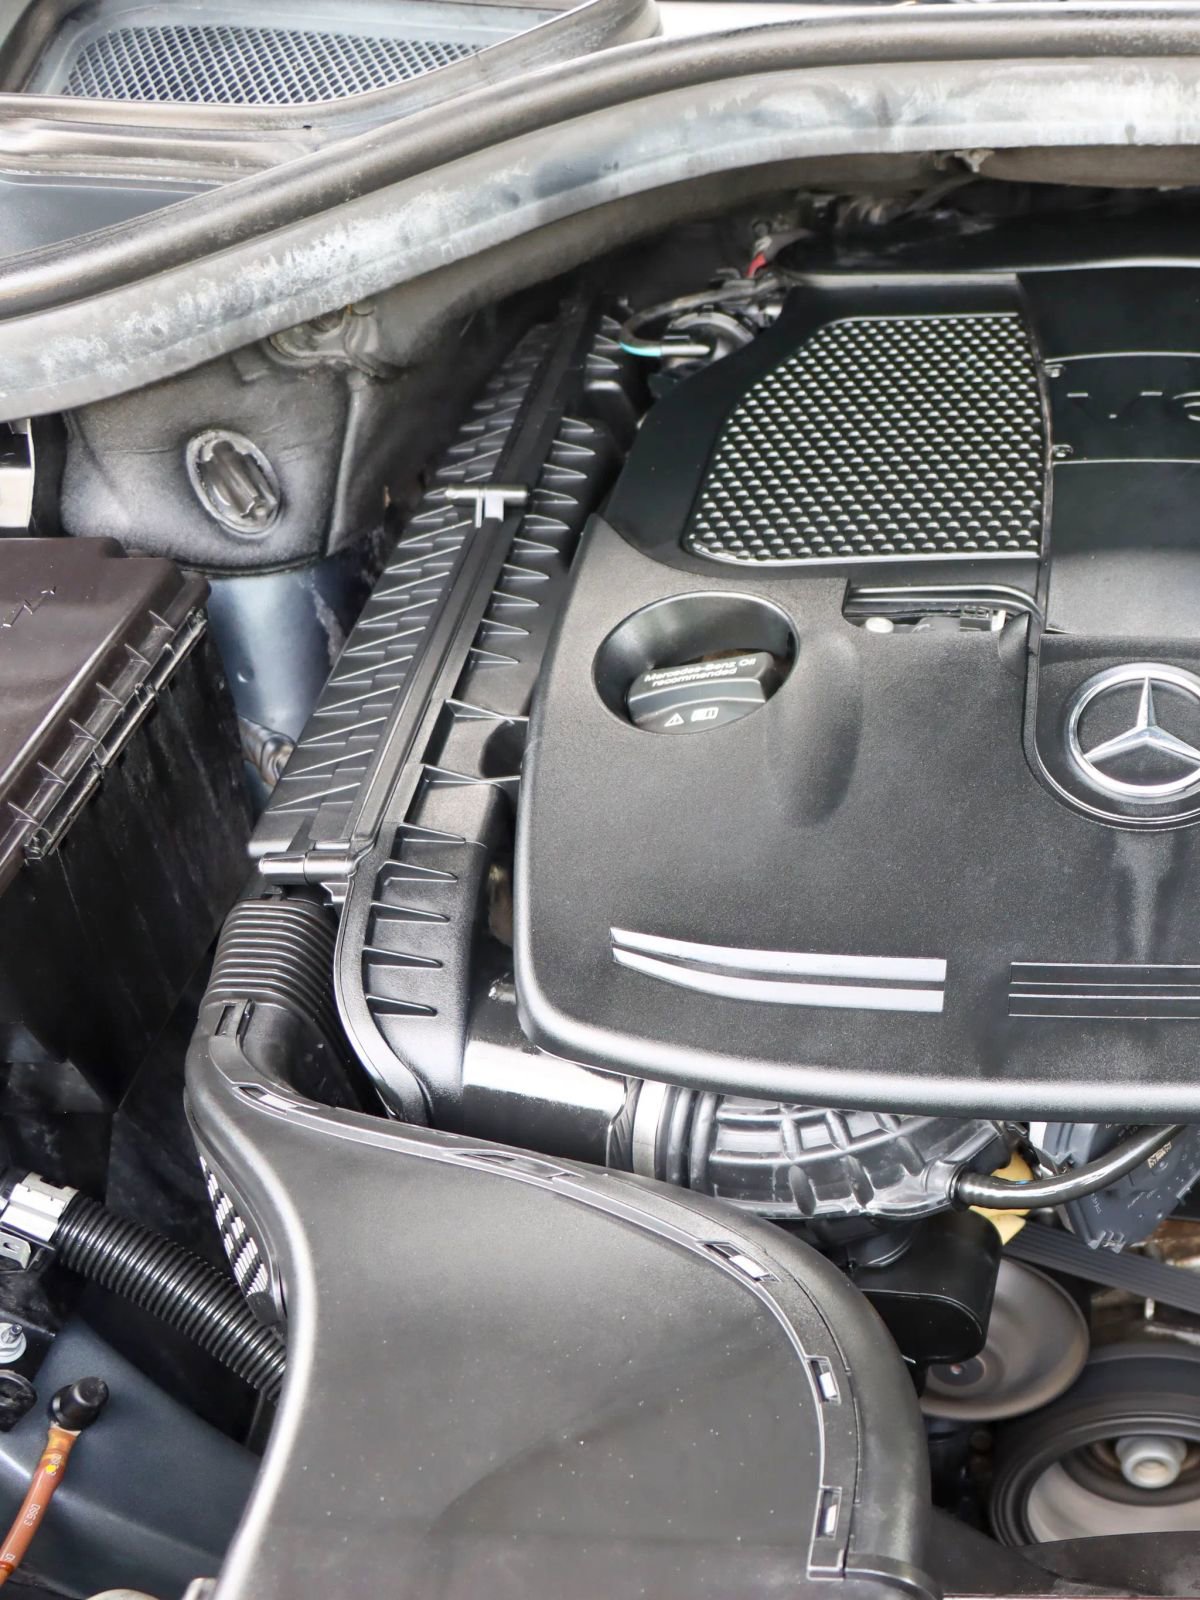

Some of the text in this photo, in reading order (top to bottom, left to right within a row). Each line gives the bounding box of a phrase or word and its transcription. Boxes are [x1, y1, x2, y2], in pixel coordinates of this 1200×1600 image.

[643, 657, 757, 683] Mercedes-Benz Oil
[651, 667, 738, 688] recommended
